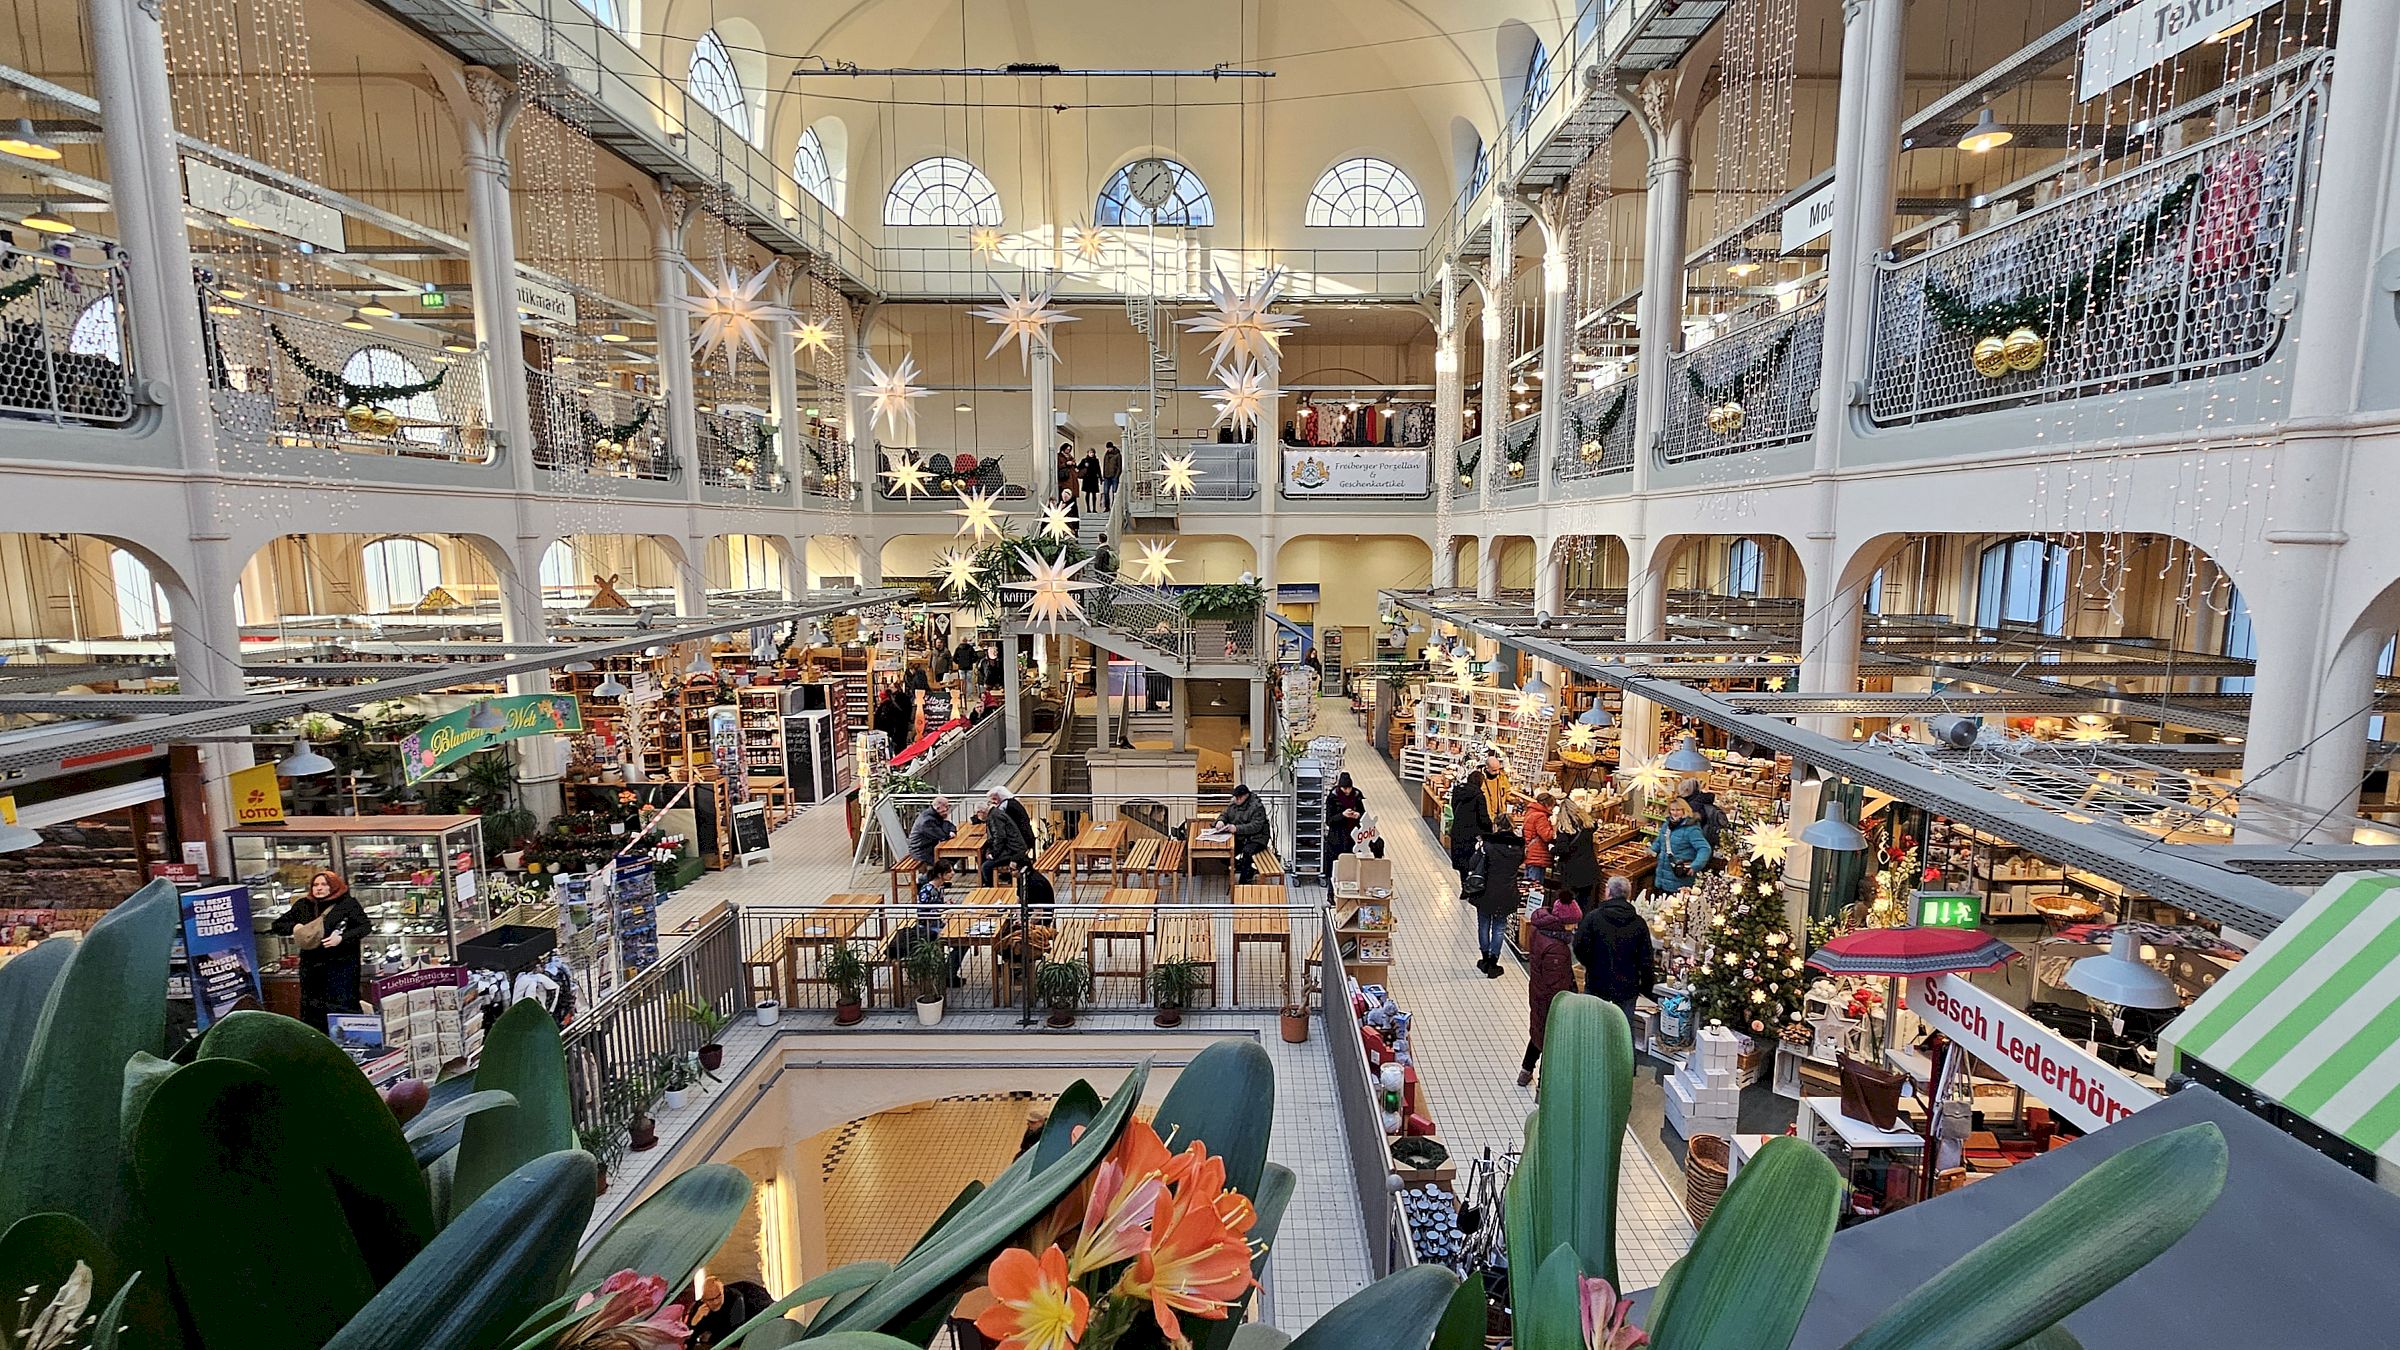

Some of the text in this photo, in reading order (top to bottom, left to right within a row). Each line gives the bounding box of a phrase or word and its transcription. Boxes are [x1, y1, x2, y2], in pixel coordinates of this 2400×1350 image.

[1809, 194, 1834, 228] Mod
[1335, 462, 1420, 471] Freiberger Porzellan
[1339, 480, 1406, 488] Geschenkartikel
[886, 633, 901, 642] EIS
[431, 701, 537, 757] Blumen Welt
[239, 806, 279, 820] LOTTO
[1357, 825, 1376, 844] goki
[194, 903, 233, 914] CHANCE
[196, 915, 235, 927] MILLION
[197, 922, 239, 937] EURO.
[198, 953, 238, 970] SACHSEN
[200, 961, 241, 977] MILLION
[387, 971, 450, 989] Lieblingsstücke
[1924, 976, 2135, 1124] Sasch Lederbörs
